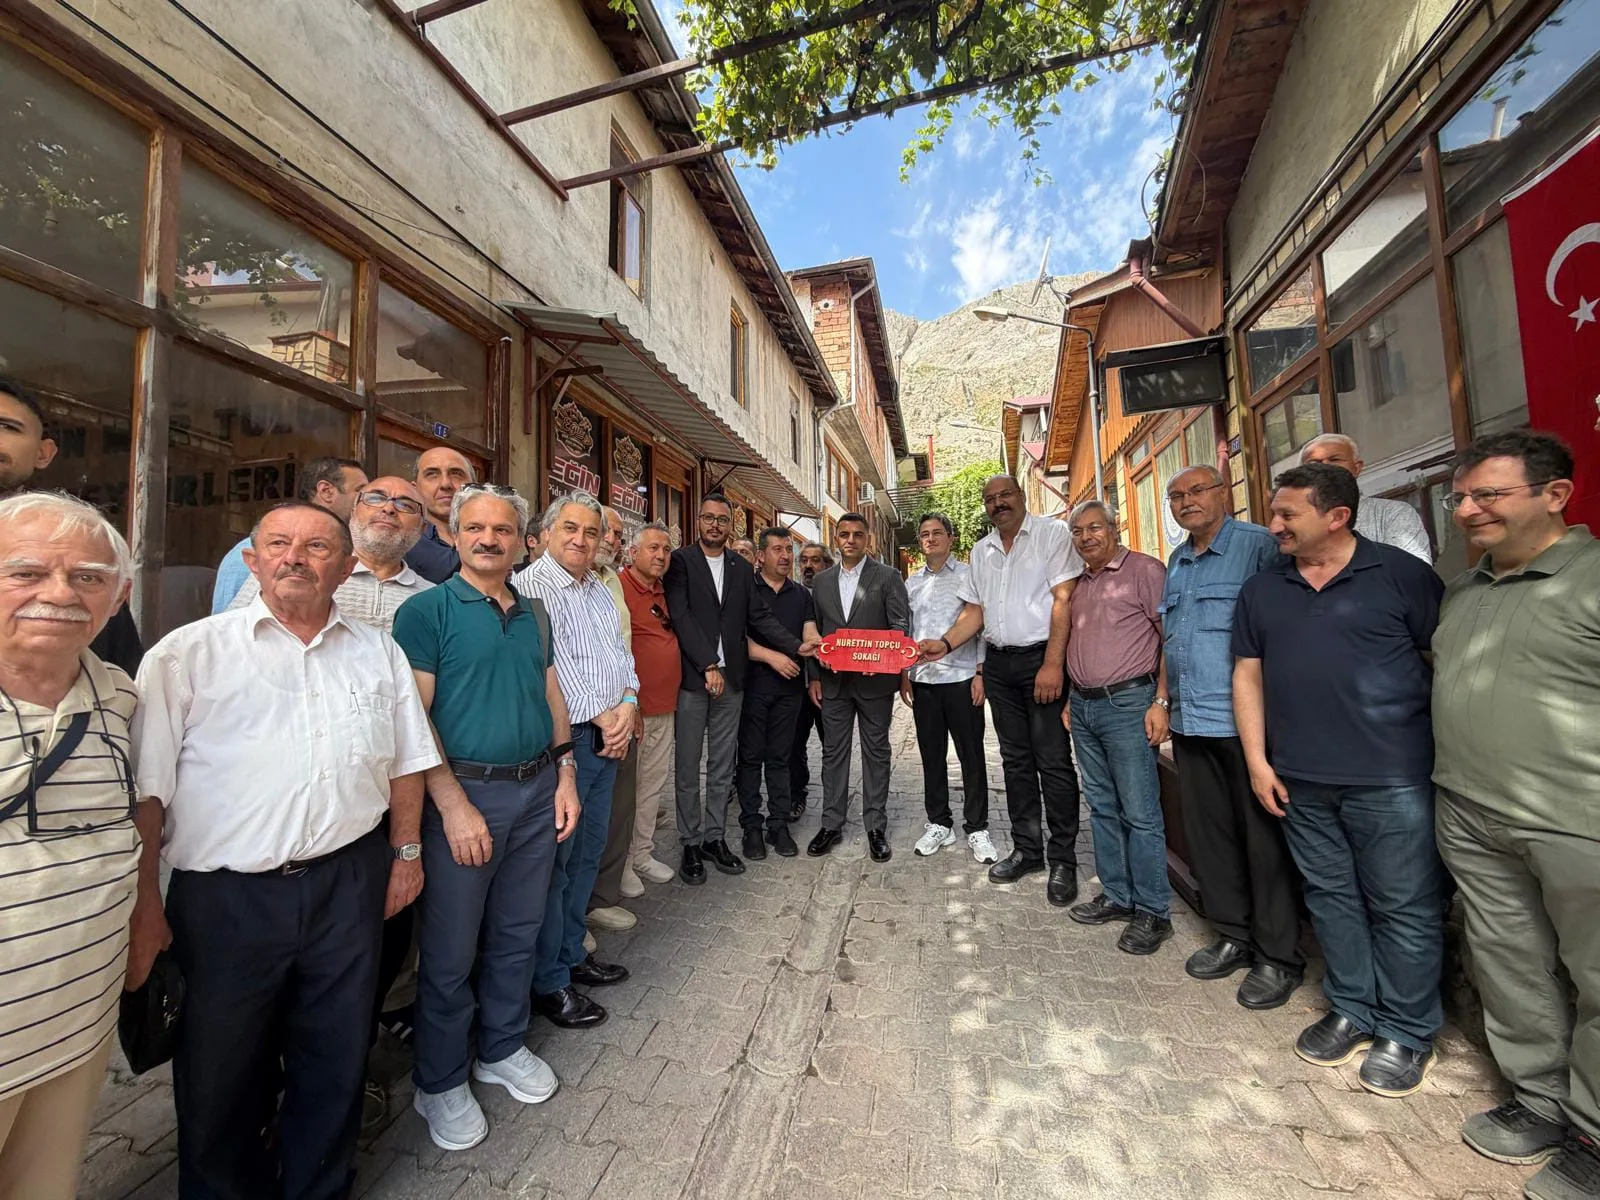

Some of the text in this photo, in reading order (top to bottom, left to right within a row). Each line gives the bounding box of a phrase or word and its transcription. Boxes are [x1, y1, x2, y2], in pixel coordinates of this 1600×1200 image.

[836, 639, 901, 650] NURETTİN TOPÇU
[852, 652, 881, 661] SOKAĞI
